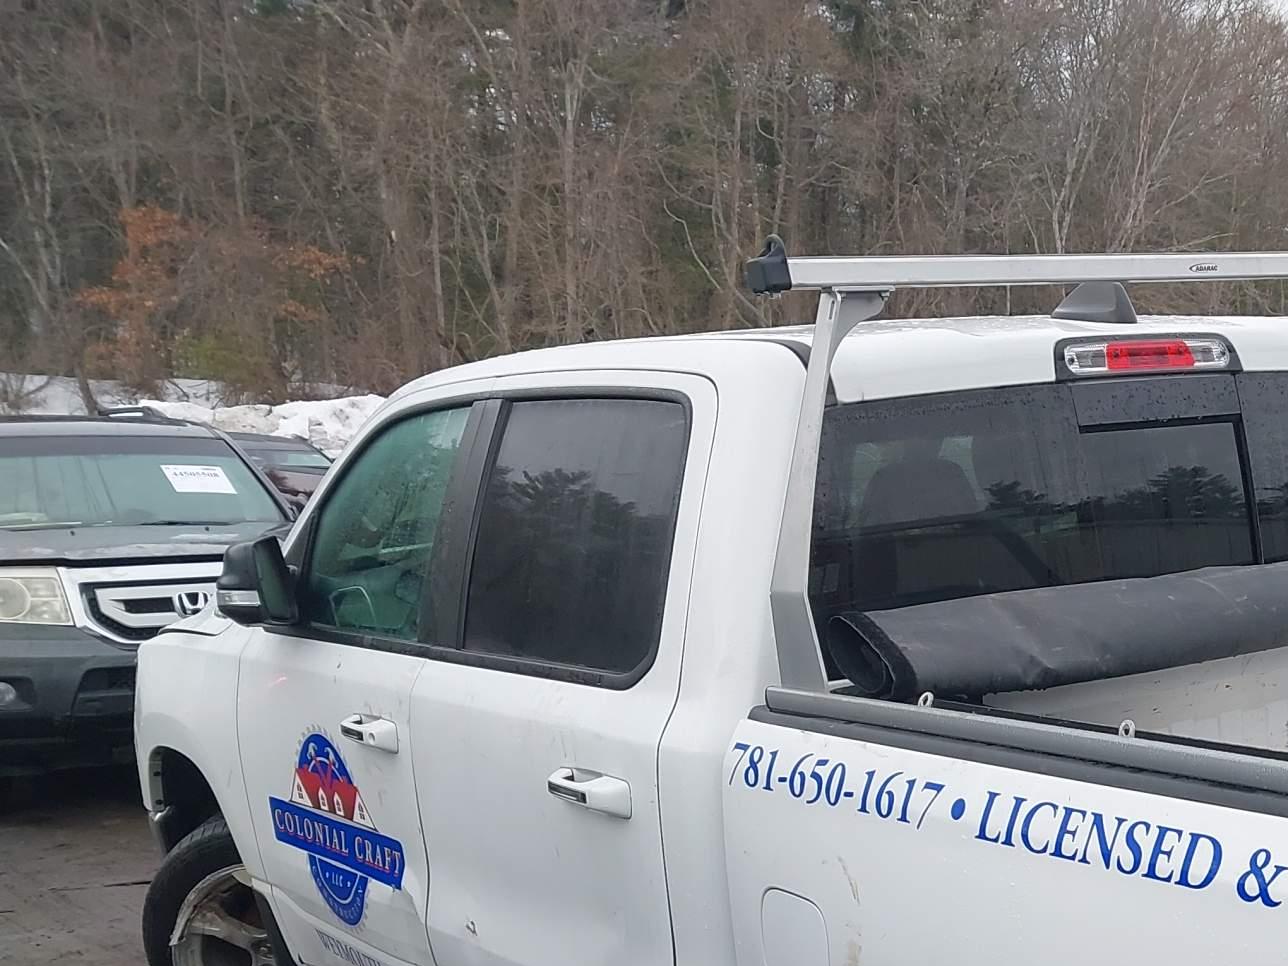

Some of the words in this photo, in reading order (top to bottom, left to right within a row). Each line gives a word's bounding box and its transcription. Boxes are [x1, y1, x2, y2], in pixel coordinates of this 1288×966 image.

[274, 808, 349, 857] COLONIAL
[354, 836, 401, 877] CRAFT
[729, 742, 946, 830] 781-650-1617
[974, 790, 1223, 890] LICENSED
[331, 871, 344, 888] LLC
